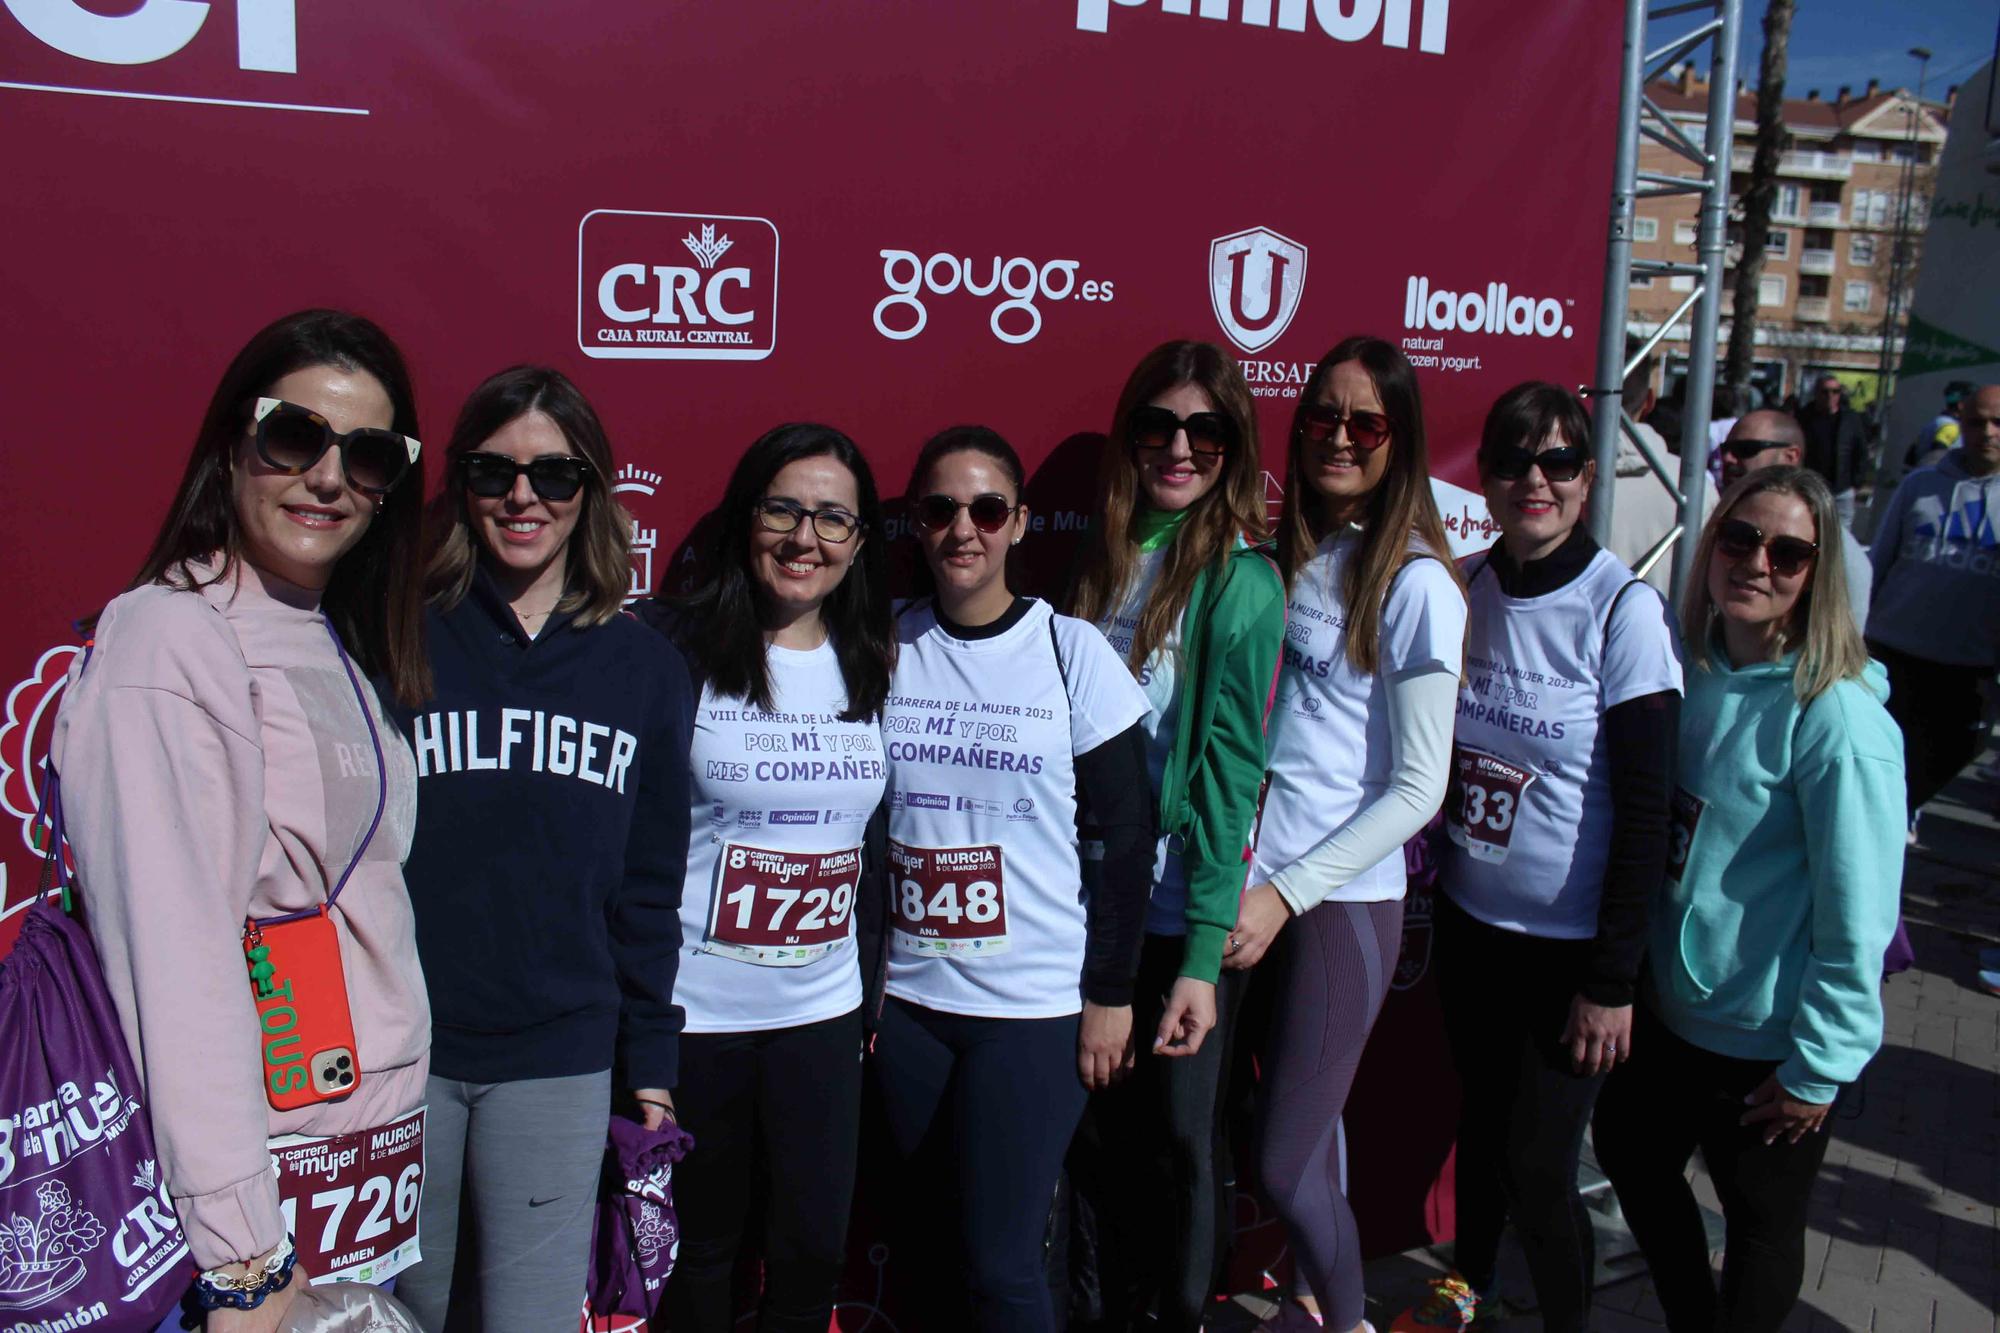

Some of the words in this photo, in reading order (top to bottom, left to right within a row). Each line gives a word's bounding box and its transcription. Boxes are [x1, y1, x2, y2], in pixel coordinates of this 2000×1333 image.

[598, 263, 754, 325] CRC
[873, 249, 1114, 344] gougo.es
[598, 329, 633, 342] CAJA
[636, 330, 684, 343] RURAL
[687, 331, 752, 344] CENTRAL
[1402, 336, 1444, 351] natural
[1441, 356, 1482, 372] yogurt.
[1282, 385, 1297, 398] de
[1296, 604, 1323, 621] MUJER
[1284, 649, 1330, 678] ERAS
[1513, 667, 1545, 685] MUJER
[1547, 676, 1575, 690] 2023
[892, 696, 941, 710] CARRERA
[945, 700, 961, 712] DE
[963, 702, 977, 713] LA
[981, 702, 1021, 716] MUJER
[1025, 707, 1053, 721] 2023
[1505, 686, 1538, 710] POR
[709, 710, 738, 722] VIII
[741, 711, 798, 724] CARRERA
[802, 713, 817, 725] DE
[820, 714, 834, 725] LA
[884, 716, 920, 734] POR
[925, 712, 956, 736] MÍ
[960, 721, 974, 739] Y
[976, 722, 1018, 743] POR
[1456, 697, 1566, 740] OMPAÑERAS
[745, 733, 788, 752] POR
[791, 726, 821, 752] MÍ
[824, 735, 837, 752] Y
[841, 734, 876, 752] POR
[413, 707, 638, 795] HILFIGER
[888, 741, 1044, 775] COMPAÑERAS
[707, 760, 748, 782] MIS
[1477, 757, 1524, 780] MURCIA
[750, 851, 784, 862] carrera
[820, 852, 856, 870] MURCIA
[935, 850, 994, 865] MURCIA
[980, 862, 996, 870] 2023
[758, 860, 809, 884] mujer
[726, 883, 852, 931] 1729
[785, 935, 800, 944] MJ
[920, 928, 939, 936] ANA
[371, 1119, 421, 1150] MURCIA
[285, 1144, 329, 1161] carrera
[376, 1149, 387, 1159] DE
[387, 1142, 410, 1156] MARZO
[299, 1147, 359, 1182] mujer
[280, 1163, 421, 1253] 1726
[330, 1246, 375, 1269] MAMEN
